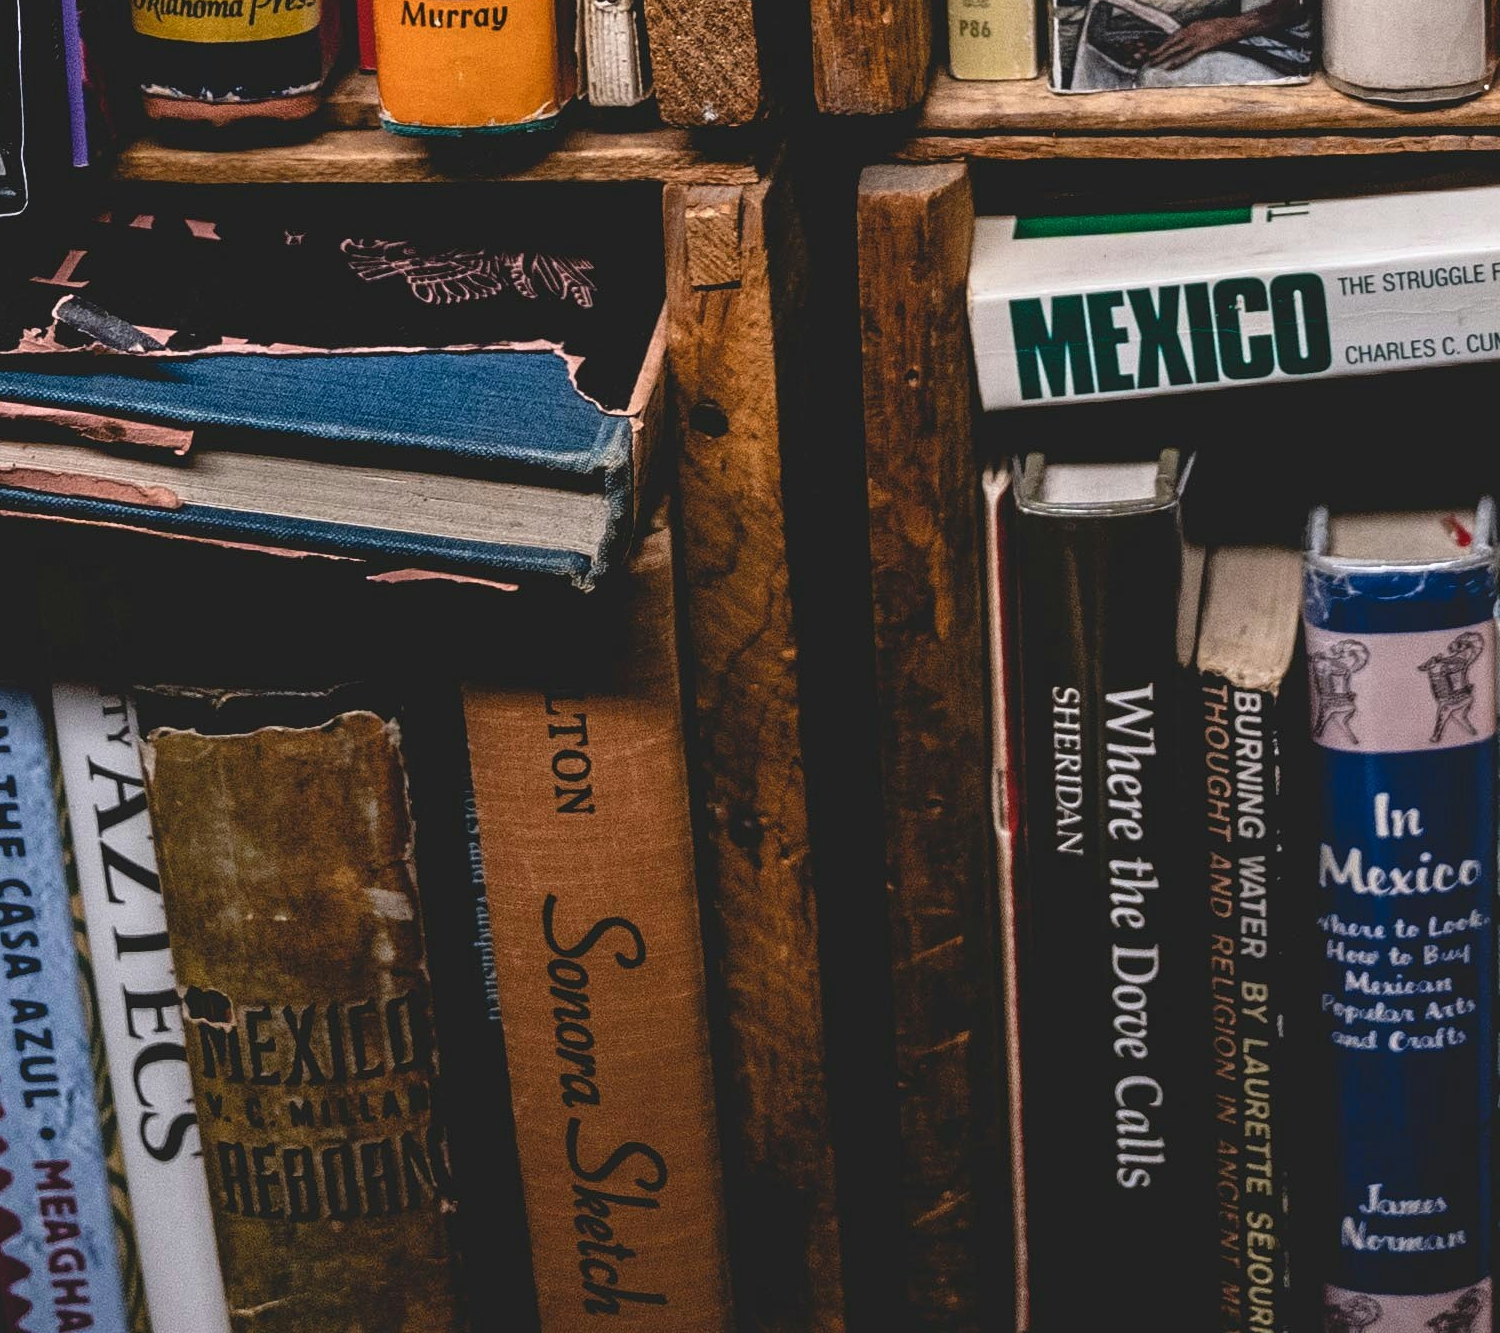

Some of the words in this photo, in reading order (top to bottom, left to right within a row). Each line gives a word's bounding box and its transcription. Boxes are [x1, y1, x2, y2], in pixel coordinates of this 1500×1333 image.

[1009, 272, 1332, 400] MEXICO
[1337, 274, 1377, 297] THE
[1382, 264, 1486, 293] STRUGGLE
[1344, 336, 1437, 365] CHARLES
[1441, 336, 1461, 355] C.
[1053, 686, 1084, 856] SHERIDAN
[1106, 683, 1154, 841] Where
[1373, 793, 1423, 837] In
[1108, 858, 1160, 931] the
[1319, 847, 1480, 897] Mexico
[1112, 944, 1160, 1061] Dove
[1115, 1075, 1163, 1189] Calls
